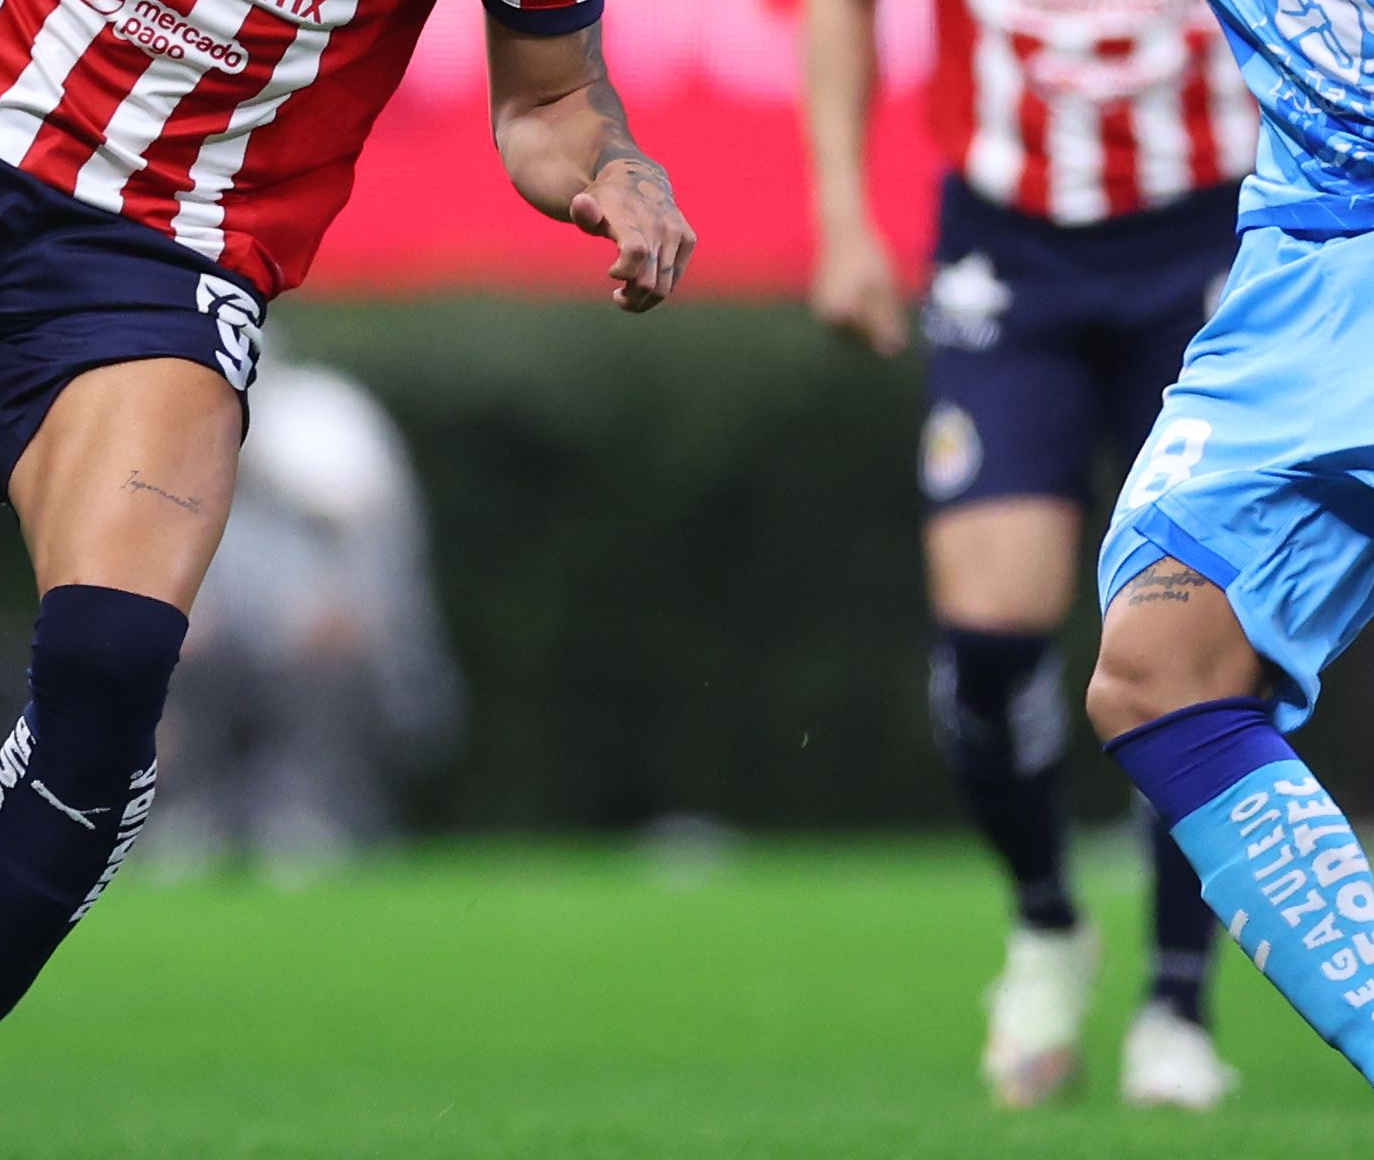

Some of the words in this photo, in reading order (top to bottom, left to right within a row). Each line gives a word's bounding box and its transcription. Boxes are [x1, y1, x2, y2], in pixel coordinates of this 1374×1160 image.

[120, 17, 186, 60] pago
[133, 0, 243, 68] mercado
[1128, 417, 1212, 511] 8
